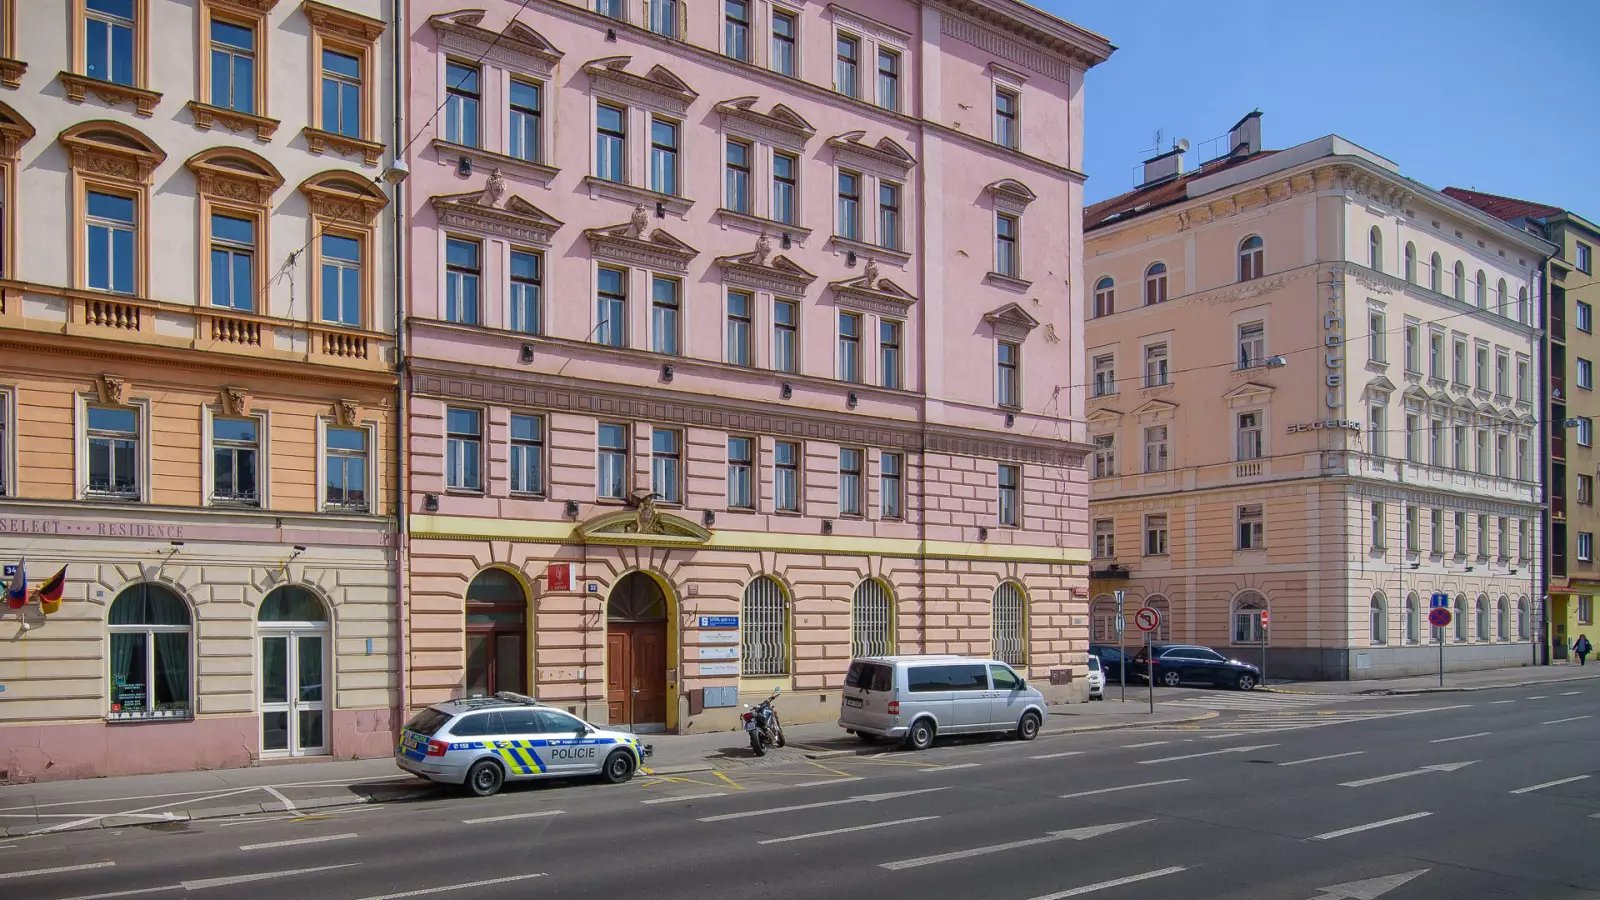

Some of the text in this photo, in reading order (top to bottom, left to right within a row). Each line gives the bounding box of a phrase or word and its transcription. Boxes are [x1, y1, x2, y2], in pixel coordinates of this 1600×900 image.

[0, 518, 184, 538] SELECT RESIDENCE
[6, 566, 17, 574] 34
[551, 747, 596, 760] POLICIE
